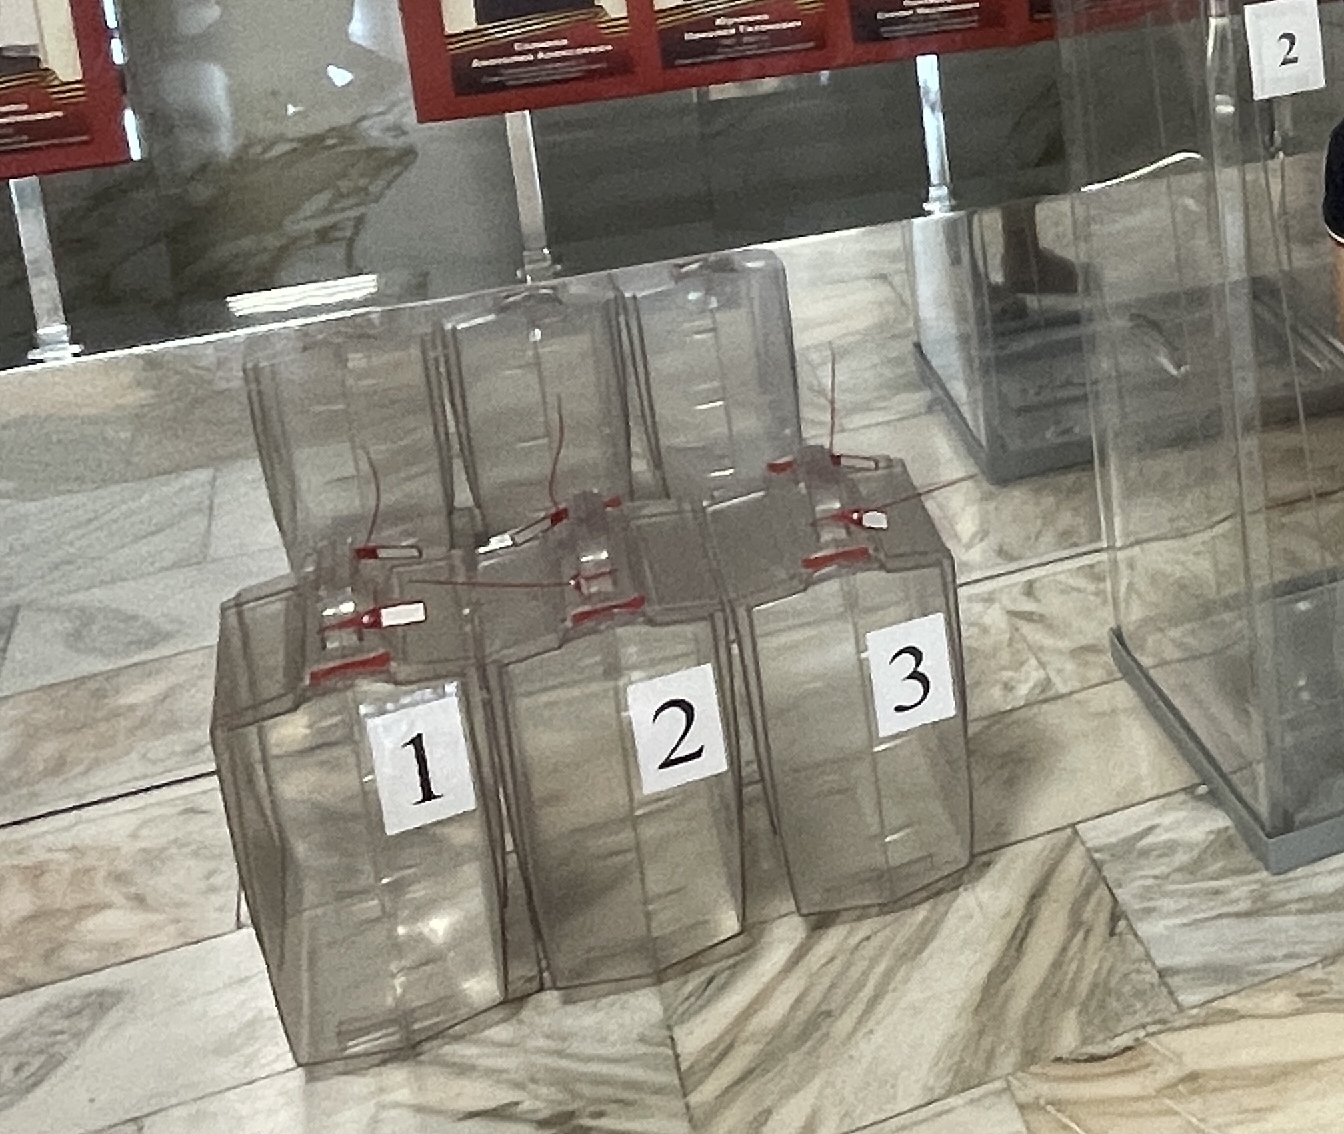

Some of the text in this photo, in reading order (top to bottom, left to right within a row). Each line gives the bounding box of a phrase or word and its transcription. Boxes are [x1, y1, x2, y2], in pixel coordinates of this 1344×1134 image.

[1279, 33, 1298, 67] 2
[890, 646, 929, 712] 3
[653, 699, 703, 769] 2
[403, 733, 443, 805] 1
